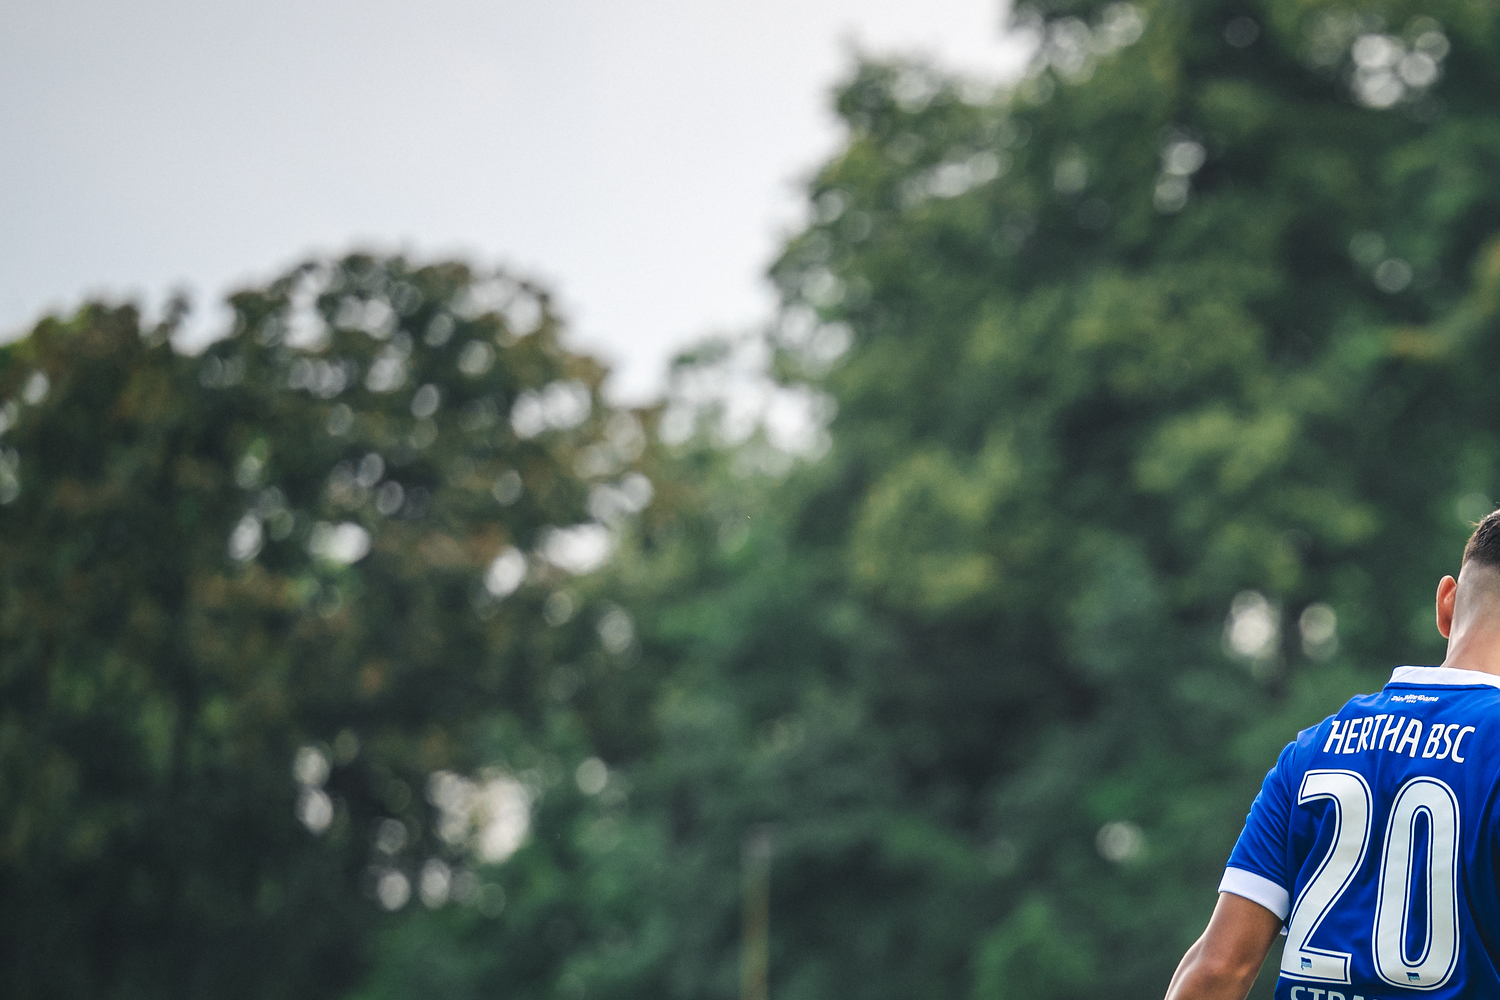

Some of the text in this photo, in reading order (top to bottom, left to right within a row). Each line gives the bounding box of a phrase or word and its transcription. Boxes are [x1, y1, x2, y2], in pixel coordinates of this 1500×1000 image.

[1323, 714, 1475, 763] HERTHA BSC
[1280, 769, 1460, 990] 20
